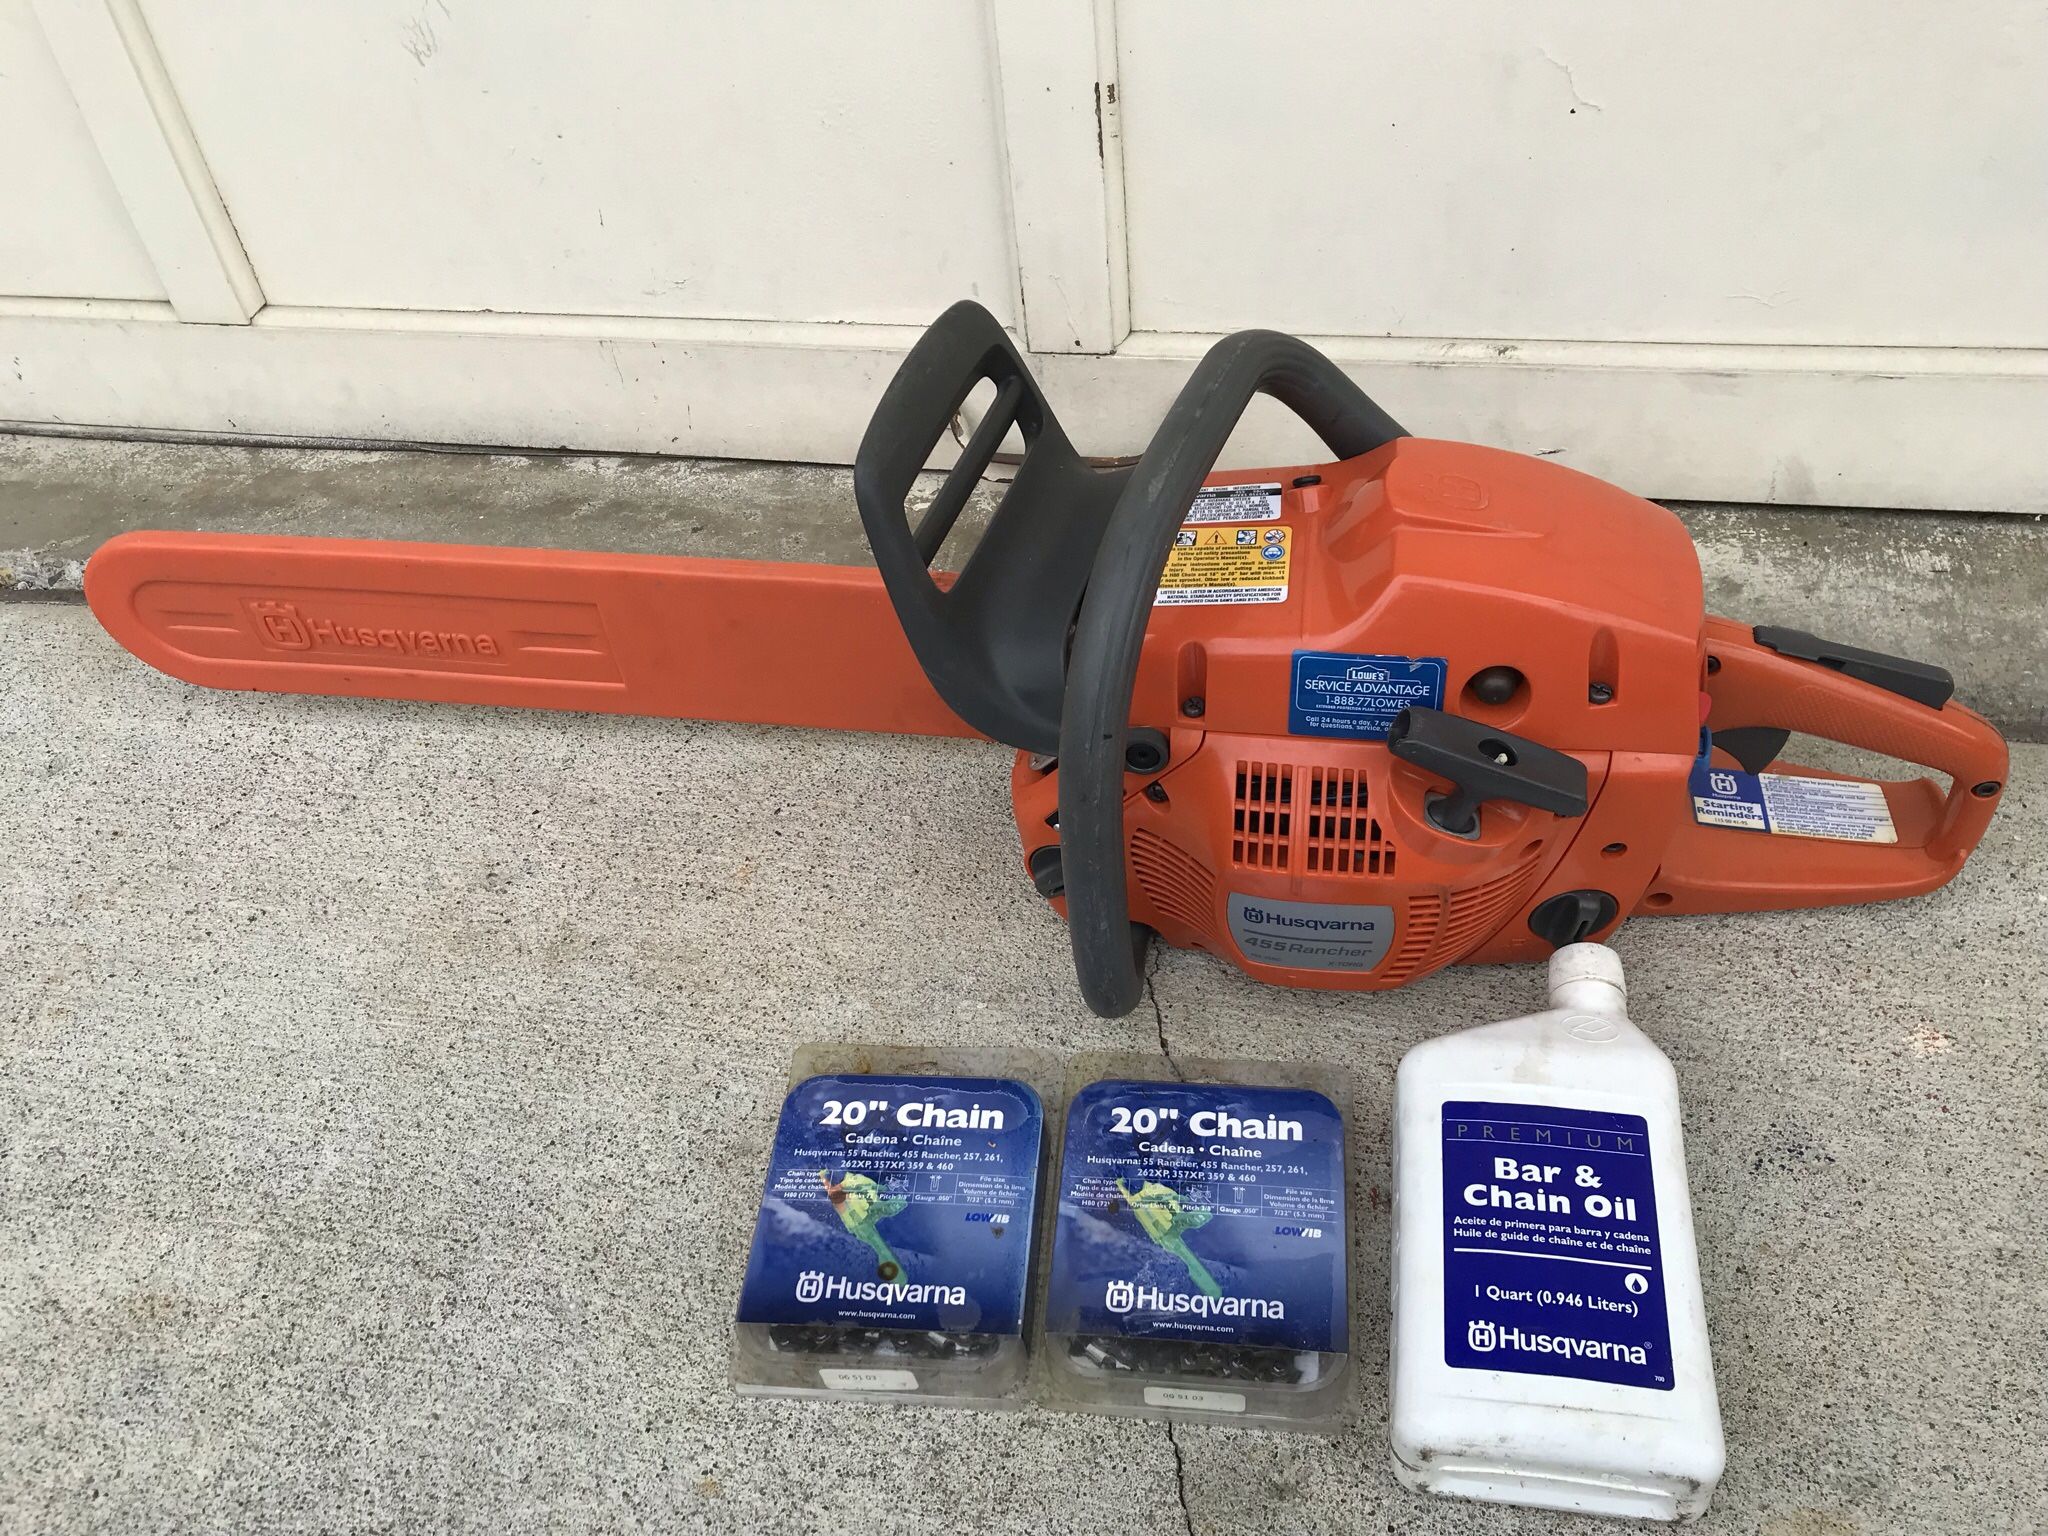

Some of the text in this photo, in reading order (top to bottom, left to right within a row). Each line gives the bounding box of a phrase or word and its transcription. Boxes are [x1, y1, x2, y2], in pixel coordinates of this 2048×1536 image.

[308, 618, 500, 656] Husqvarna
[1304, 679, 1430, 696] SERVICE ADVANTAGE
[1325, 695, 1411, 709] 1-888-77LOWES
[1696, 806, 1763, 820] Reminders
[1703, 800, 1754, 813] Starting
[1266, 912, 1375, 931] Husqvarna
[1244, 936, 1287, 952] 455
[1288, 942, 1372, 957] Rancher
[819, 1100, 1004, 1130] 20" Chain
[1108, 1106, 1304, 1142] 20" Chain
[845, 1132, 962, 1147] Cadena Chaîne
[1457, 1124, 1633, 1152] PREMIUM
[794, 1148, 1004, 1162] Husqvarna: 55 Rancher, 455 Rancher, 257, 261,
[1138, 1142, 1262, 1158] Cadena Chaîne
[840, 1160, 954, 1171] 262XP, 357XP, 359 & 460
[1086, 1155, 1308, 1176] Husqvarna: 55 Rancher, 455 Rancher, 257, 261,
[1494, 1156, 1603, 1188] Bar &
[1136, 1168, 1256, 1183] 262XP, 357XP, 359 & 460
[1264, 1194, 1300, 1202] Dimension
[1463, 1184, 1637, 1222] Chain Oil
[1220, 1206, 1241, 1214] Gauge
[1454, 1215, 1650, 1242] Aceite de primera para barra y cadena
[1454, 1228, 1652, 1255] Huile de guide de chaîne et de chaîne
[825, 1275, 966, 1306] Husqvarna
[1136, 1285, 1285, 1320] Husqvarna
[1486, 1285, 1532, 1302] Quart
[1536, 1289, 1583, 1307] (0.946
[1588, 1295, 1639, 1318] Liters)
[838, 1308, 916, 1320] www.husqvarna.com
[1152, 1320, 1234, 1334] www.husqvarna.com
